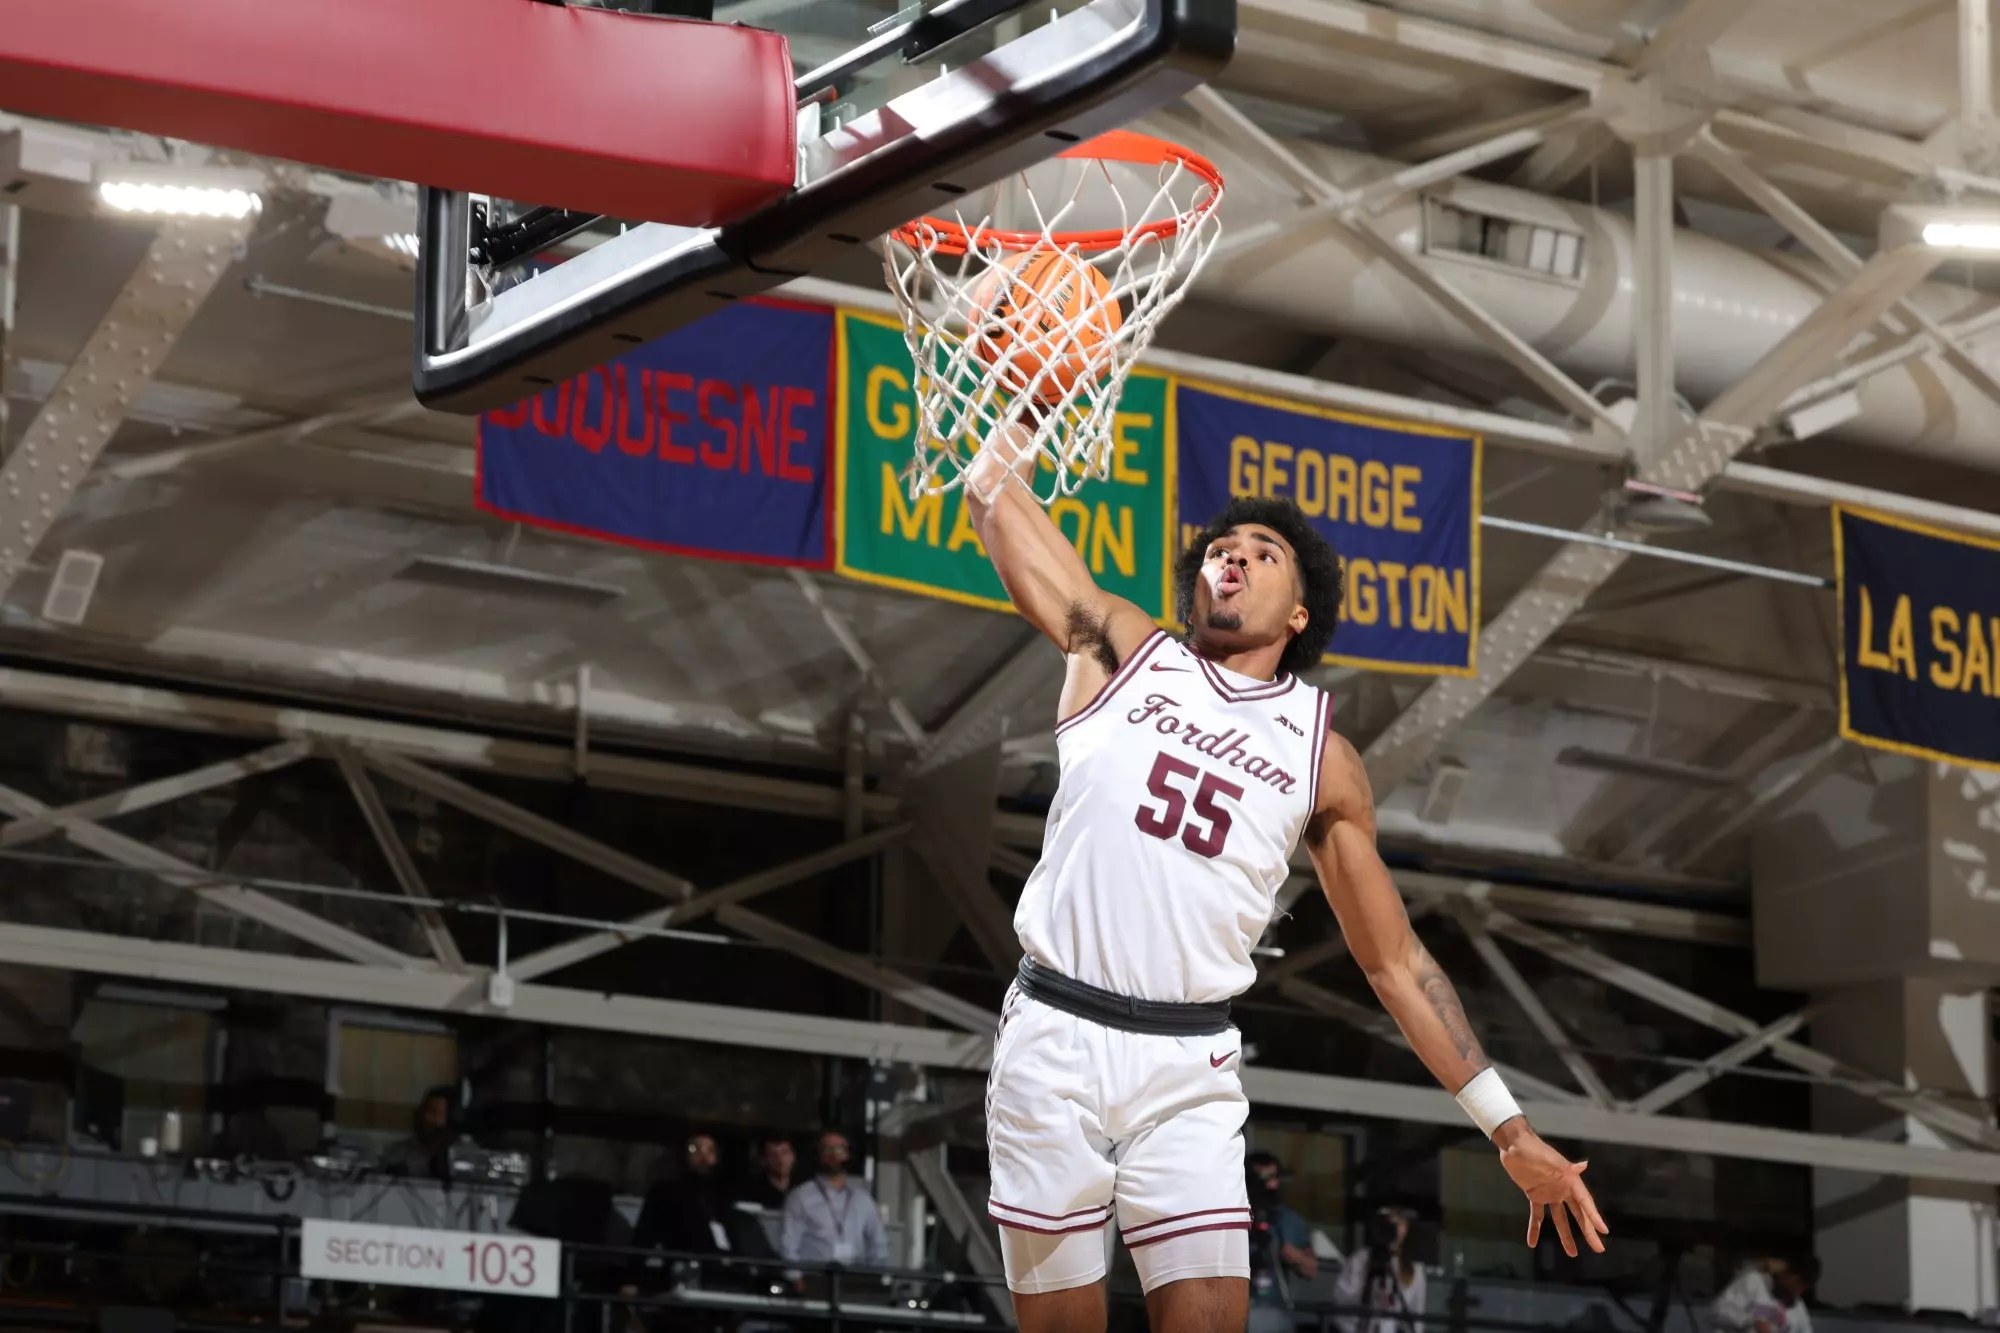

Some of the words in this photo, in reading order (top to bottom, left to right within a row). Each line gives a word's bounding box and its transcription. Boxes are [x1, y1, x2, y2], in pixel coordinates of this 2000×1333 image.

[880, 461, 1136, 577] MAON
[1229, 434, 1422, 533] GEORGE
[1858, 584, 1918, 682] LA
[1126, 693, 1296, 795] Fordham
[1134, 750, 1245, 859] 55
[325, 1236, 446, 1270] SECTION
[462, 1240, 537, 1287] 103
